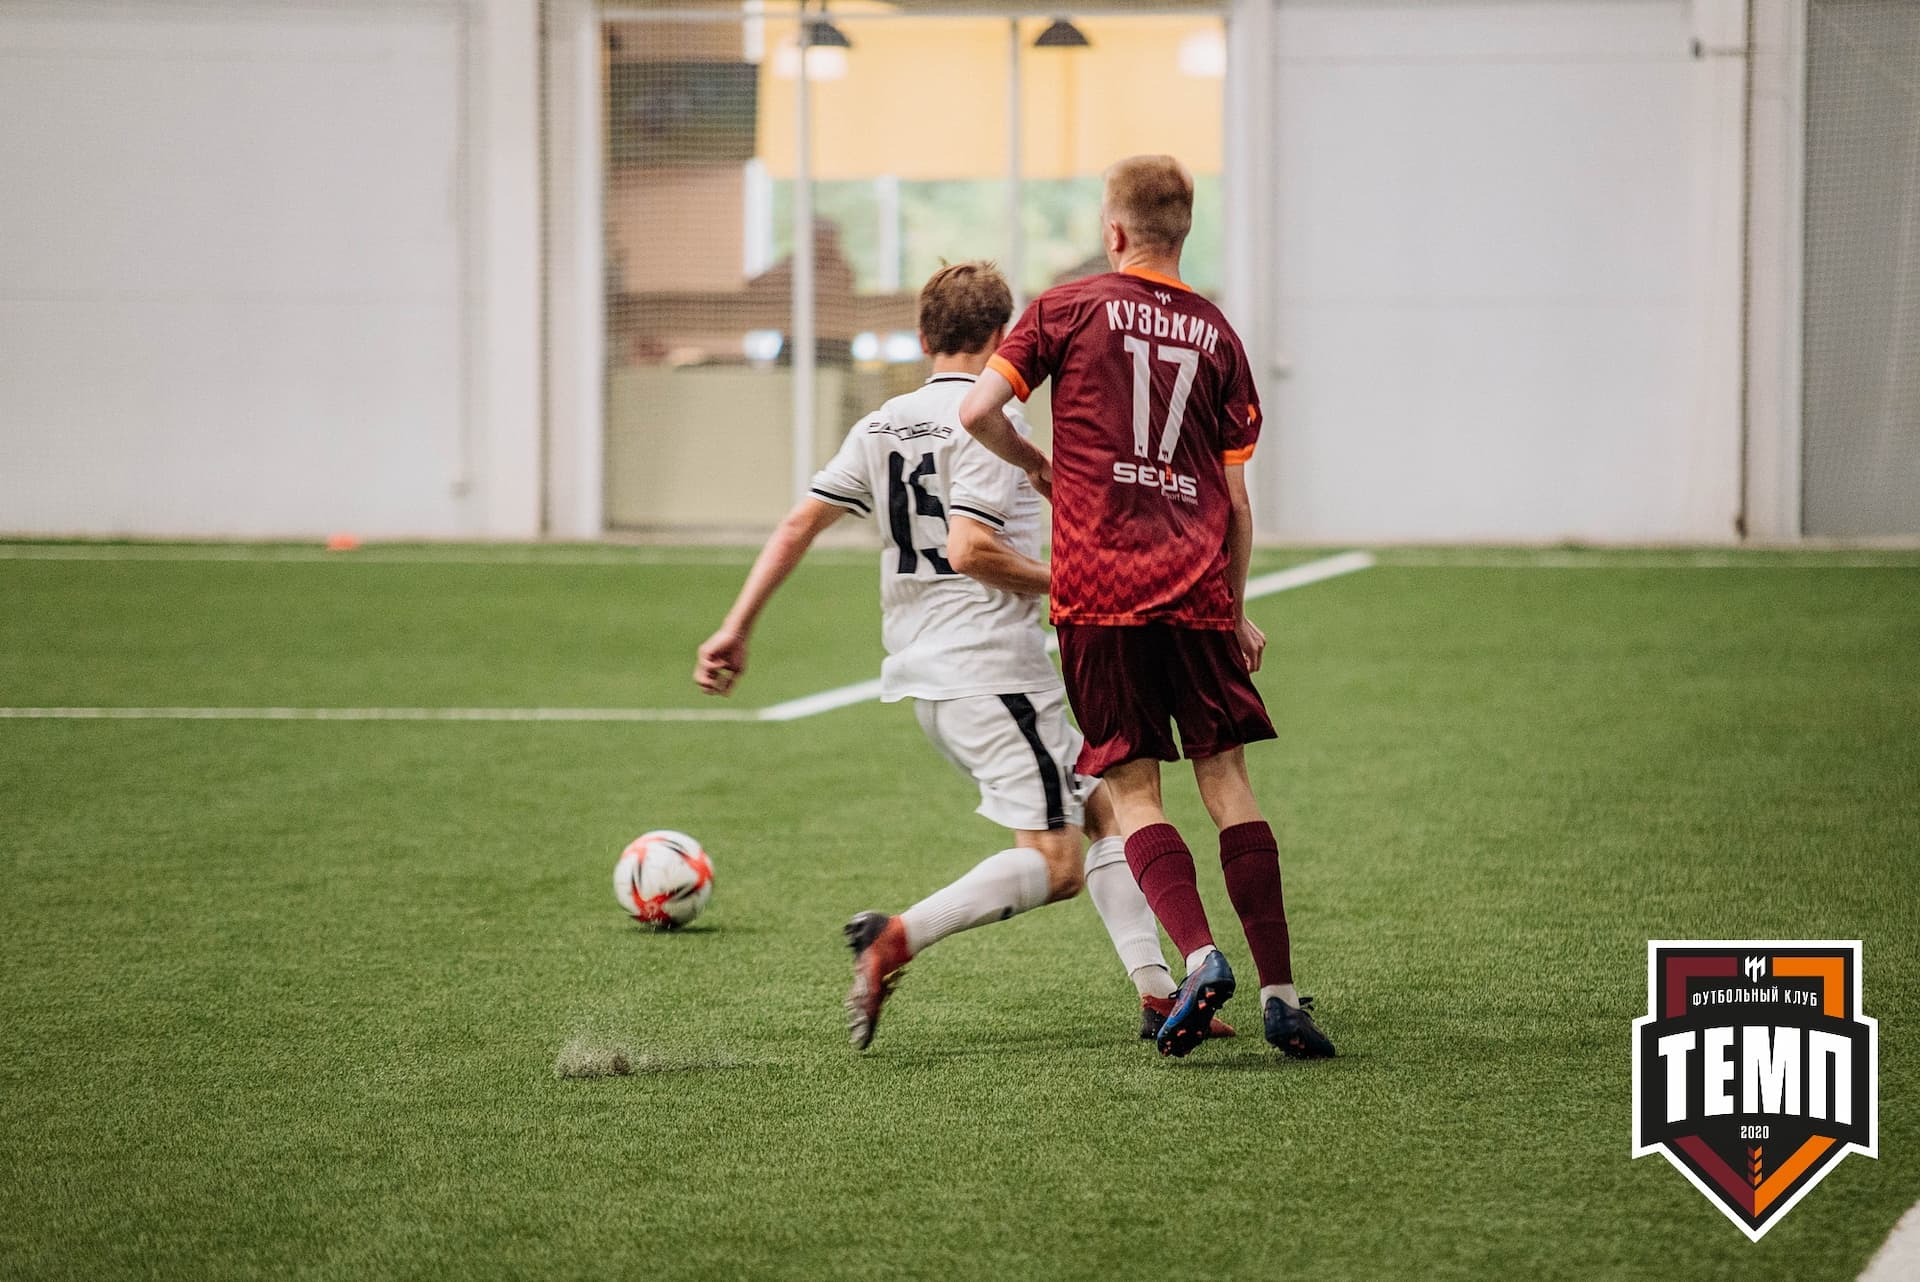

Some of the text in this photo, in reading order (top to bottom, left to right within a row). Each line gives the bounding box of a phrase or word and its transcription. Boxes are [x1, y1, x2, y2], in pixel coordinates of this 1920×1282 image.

[1106, 300, 1219, 354] КУЗЬКИН
[1123, 334, 1199, 464] 17
[889, 451, 960, 574] 15
[1112, 462, 1197, 497] SEUS
